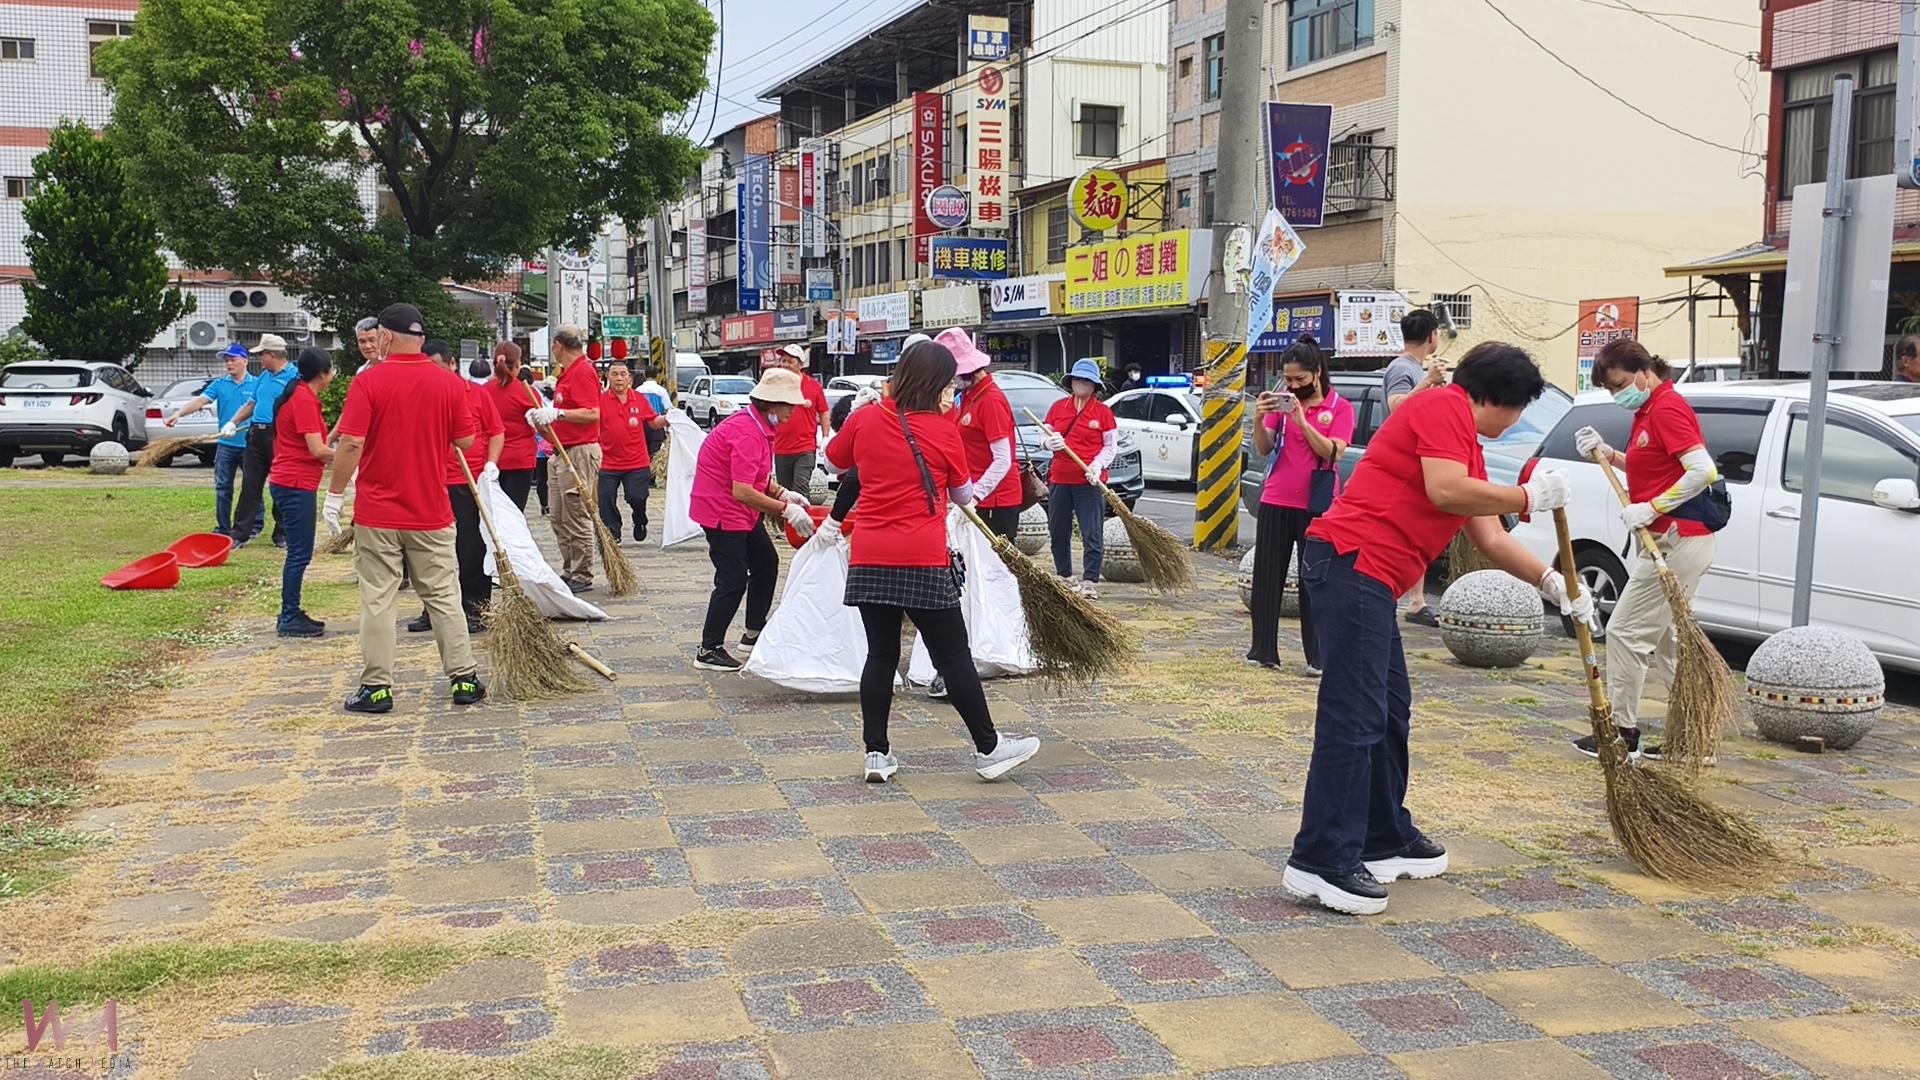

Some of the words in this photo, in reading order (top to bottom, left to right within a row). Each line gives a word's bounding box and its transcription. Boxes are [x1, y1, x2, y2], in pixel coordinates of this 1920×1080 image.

[976, 98, 1006, 110] SYM
[752, 163, 763, 207] TECO
[921, 130, 935, 210] SAKUR
[979, 121, 1002, 223] 三陽機車
[1082, 174, 1122, 219] 麵
[690, 227, 705, 286] YAMAHA
[935, 246, 1007, 271] 機車維修
[1073, 239, 1178, 284] 二姐の麵攤
